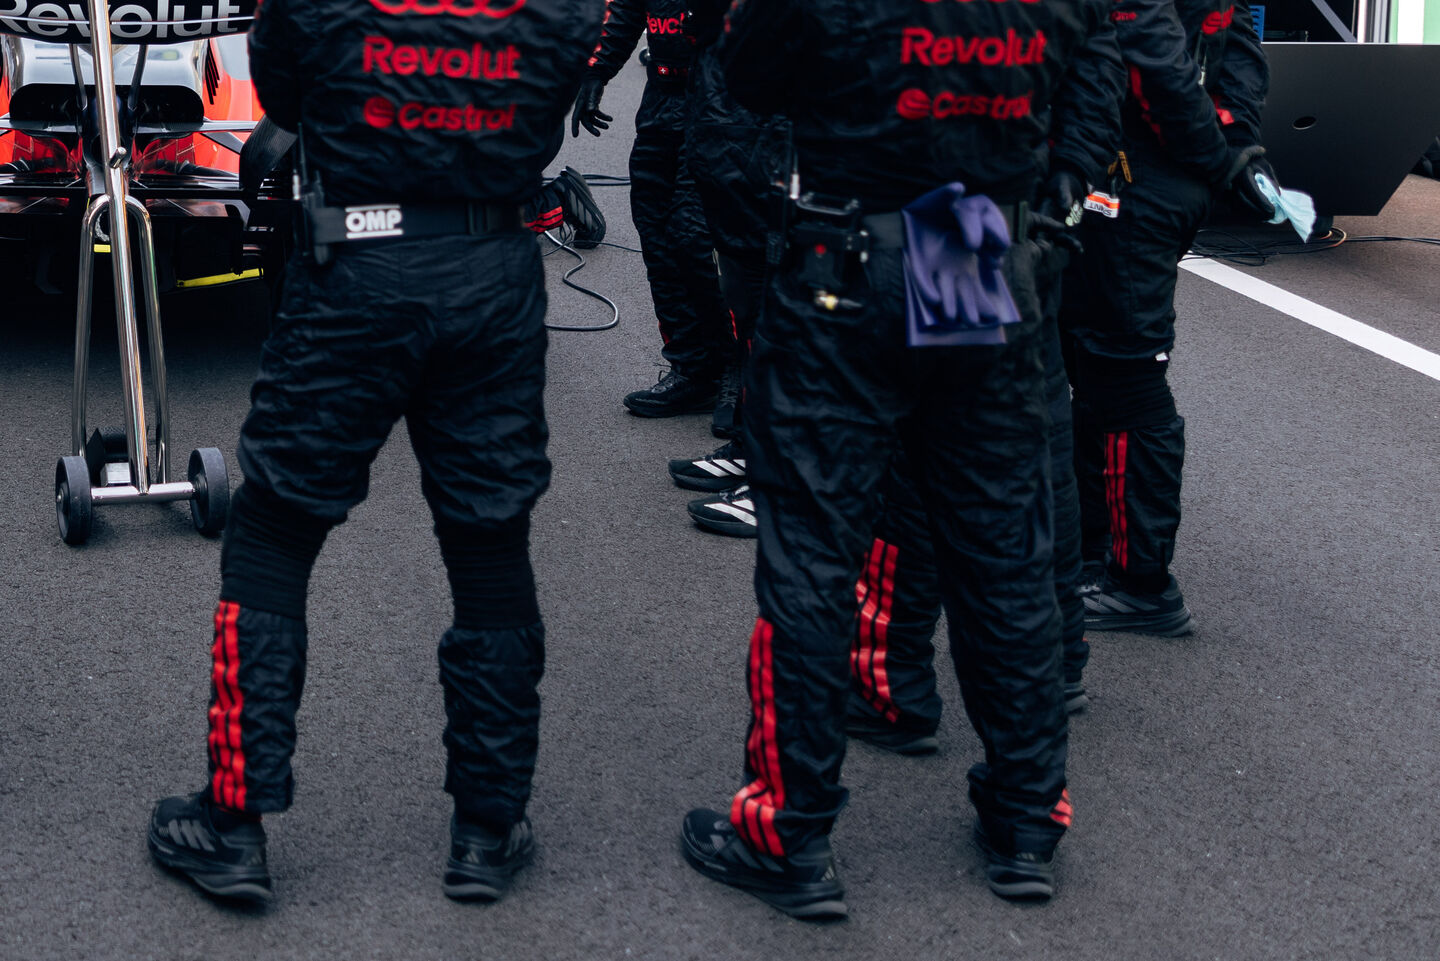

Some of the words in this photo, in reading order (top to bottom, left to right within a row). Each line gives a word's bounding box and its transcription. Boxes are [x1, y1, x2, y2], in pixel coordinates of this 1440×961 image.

[364, 37, 520, 79] Revolut
[902, 28, 1046, 66] Revolut
[399, 104, 513, 130] Castrol
[934, 92, 1029, 118] Castrol
[345, 209, 403, 233] OMP
